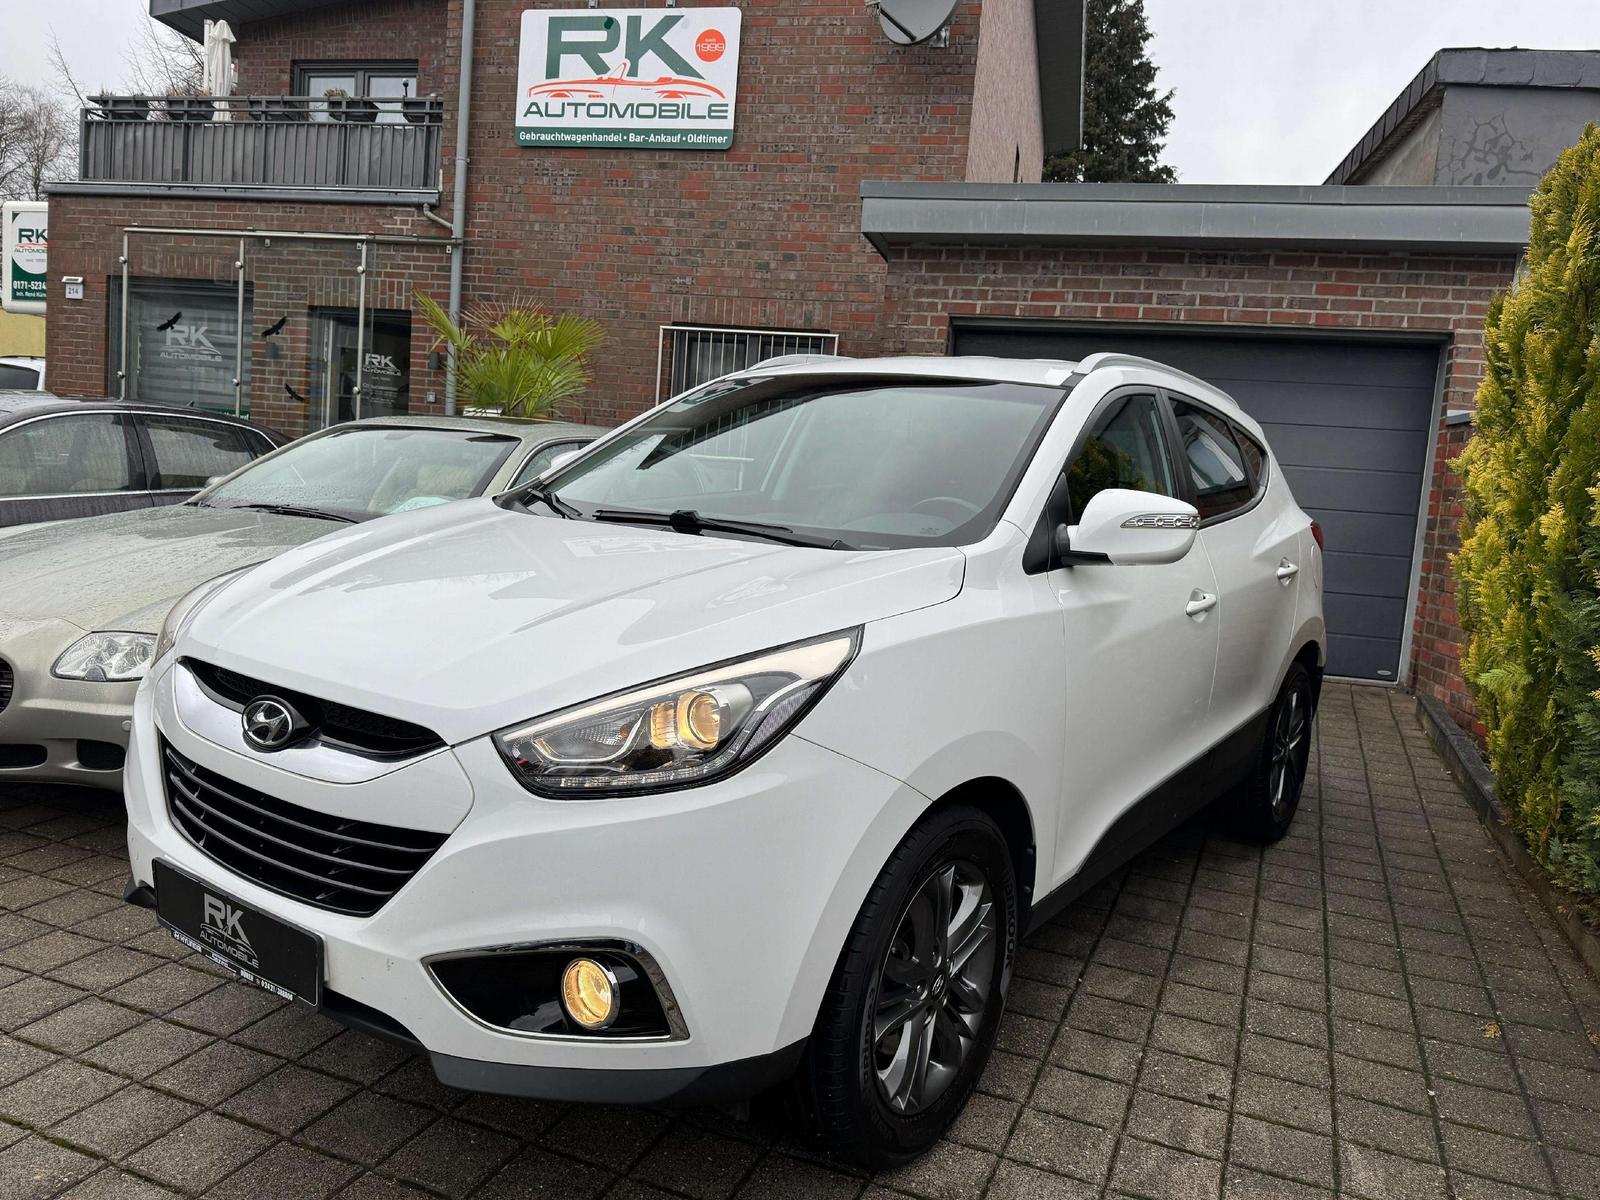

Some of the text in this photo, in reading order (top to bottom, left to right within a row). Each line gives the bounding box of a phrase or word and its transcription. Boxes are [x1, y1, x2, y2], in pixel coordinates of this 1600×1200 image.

[545, 15, 706, 80] RK
[523, 102, 729, 120] AUTOMOBILE
[519, 131, 728, 144] Gebrauchtwagenhandel Bar-Ankauf Oldtimer
[18, 228, 48, 243] RK
[68, 287, 79, 295] 214
[165, 325, 216, 349] RK
[364, 353, 398, 369] RK
[203, 892, 252, 946] RK
[200, 930, 260, 969] AUTOMOBILE
